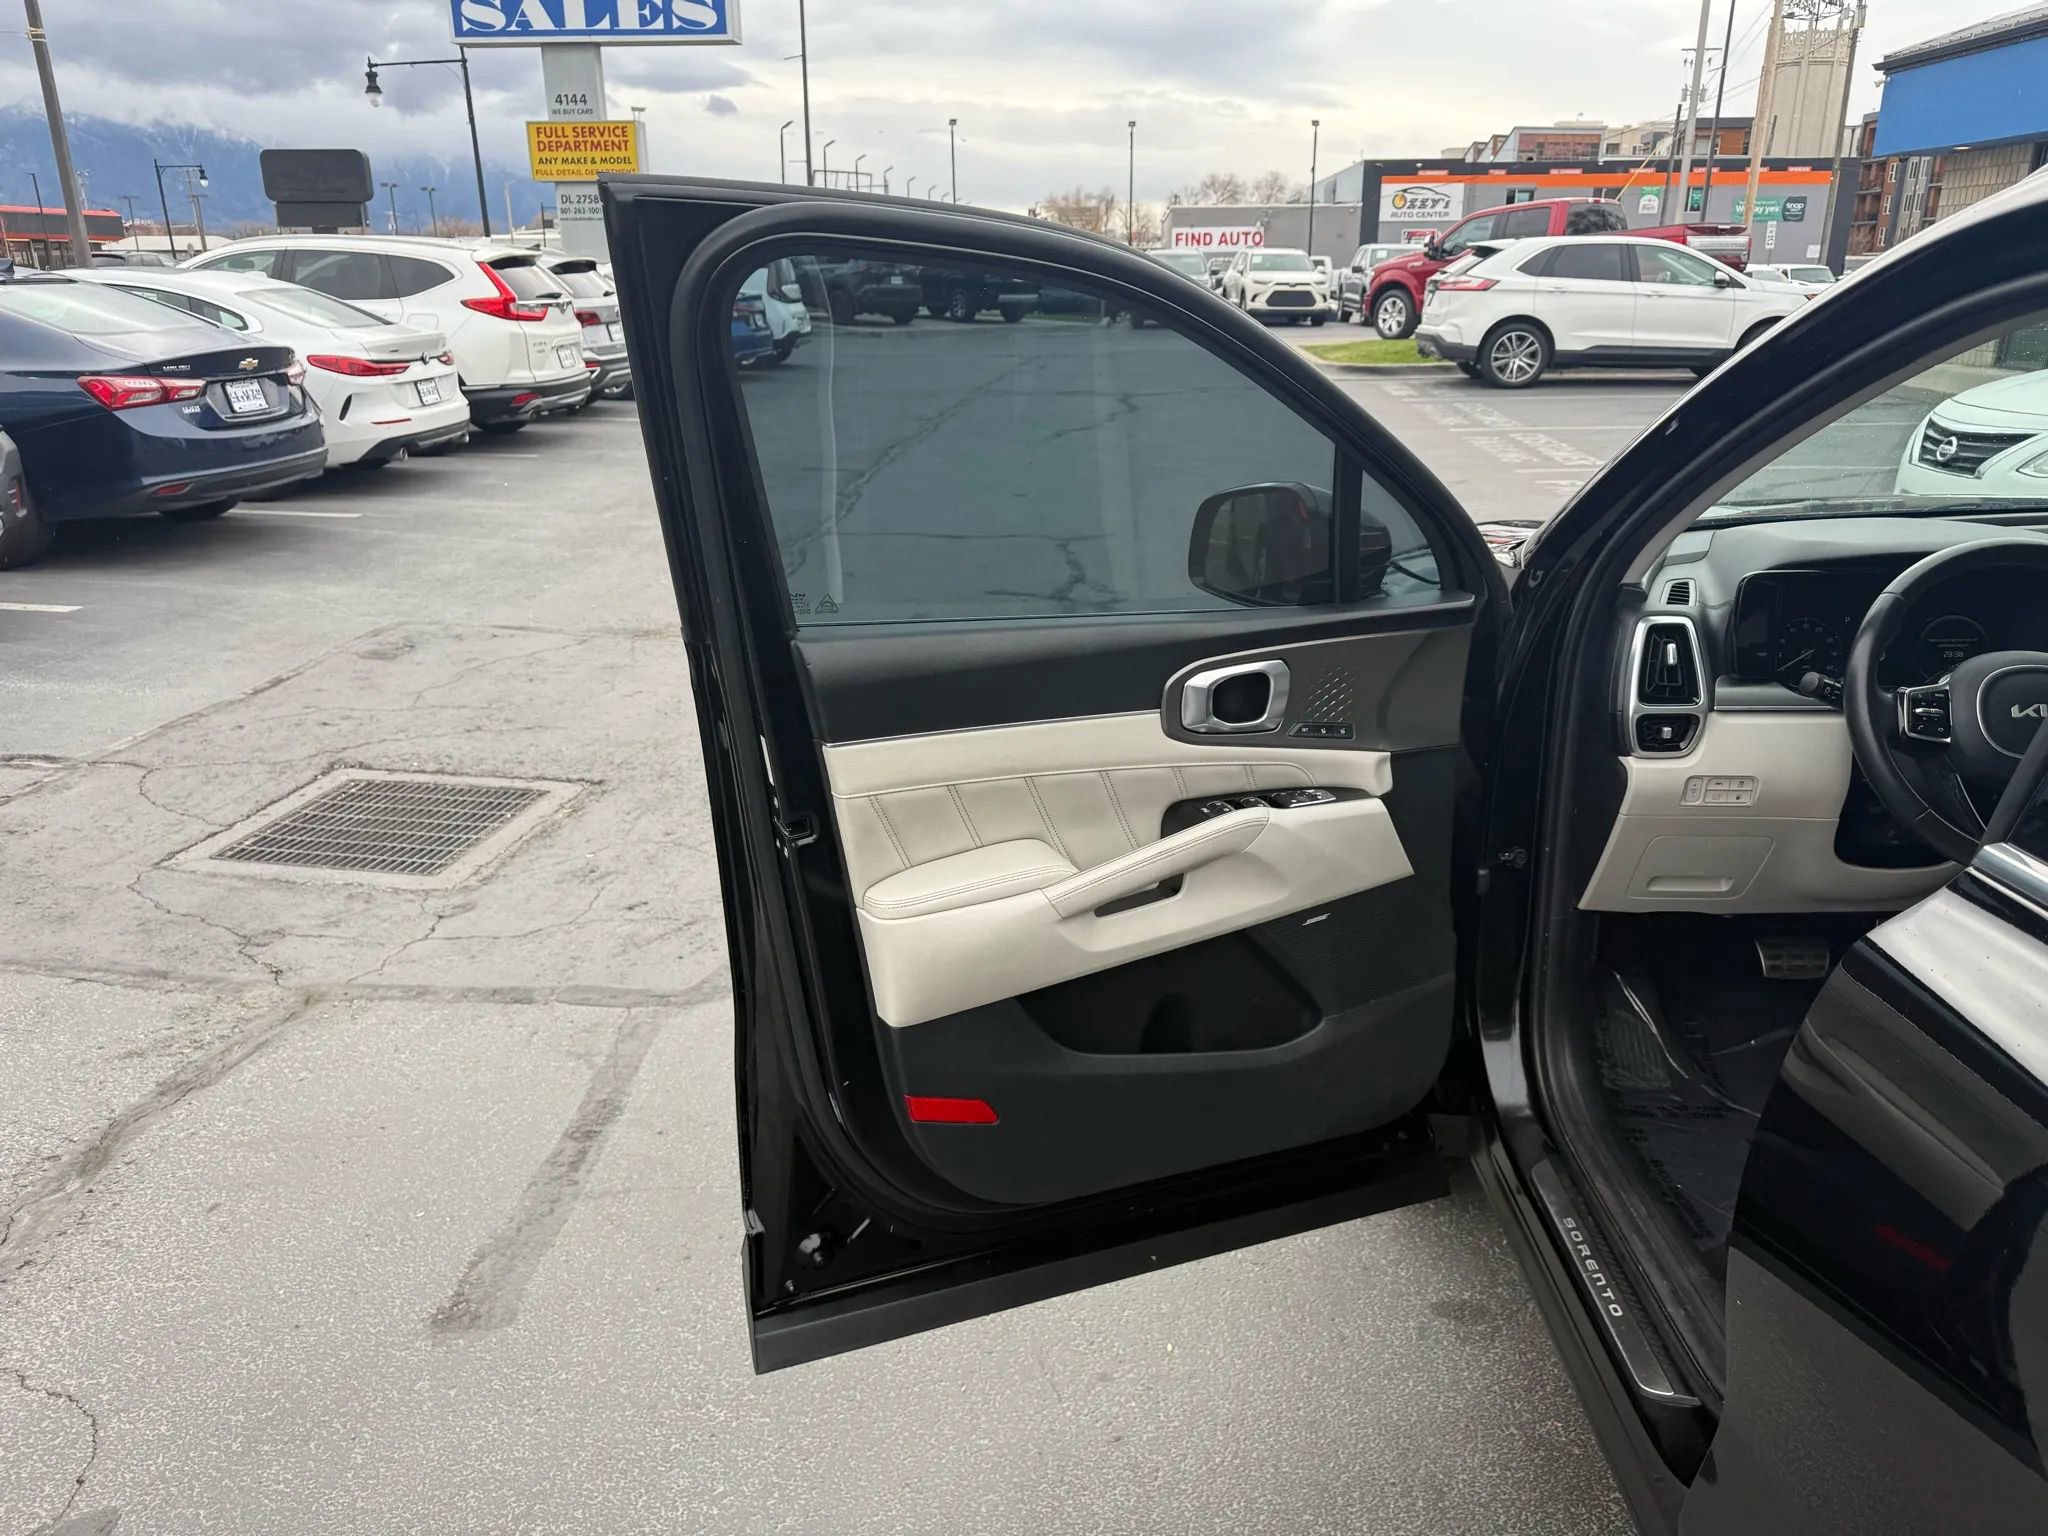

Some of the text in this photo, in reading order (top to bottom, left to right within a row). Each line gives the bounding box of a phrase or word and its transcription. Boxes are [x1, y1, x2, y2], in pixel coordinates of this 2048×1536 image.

[461, 0, 719, 32] SALES
[555, 93, 588, 106] 4144
[536, 126, 628, 138] FULL SERVICE
[537, 140, 630, 152] DEPARTMENT
[538, 157, 558, 165] ANY
[561, 157, 588, 165] MAKE
[600, 156, 632, 164] MODEL
[535, 168, 552, 176] FULL
[556, 168, 582, 176] DETAIL
[561, 194, 573, 204] DL
[1175, 231, 1263, 247] FIND AUTO
[1562, 1217, 1623, 1317] SORENTO
